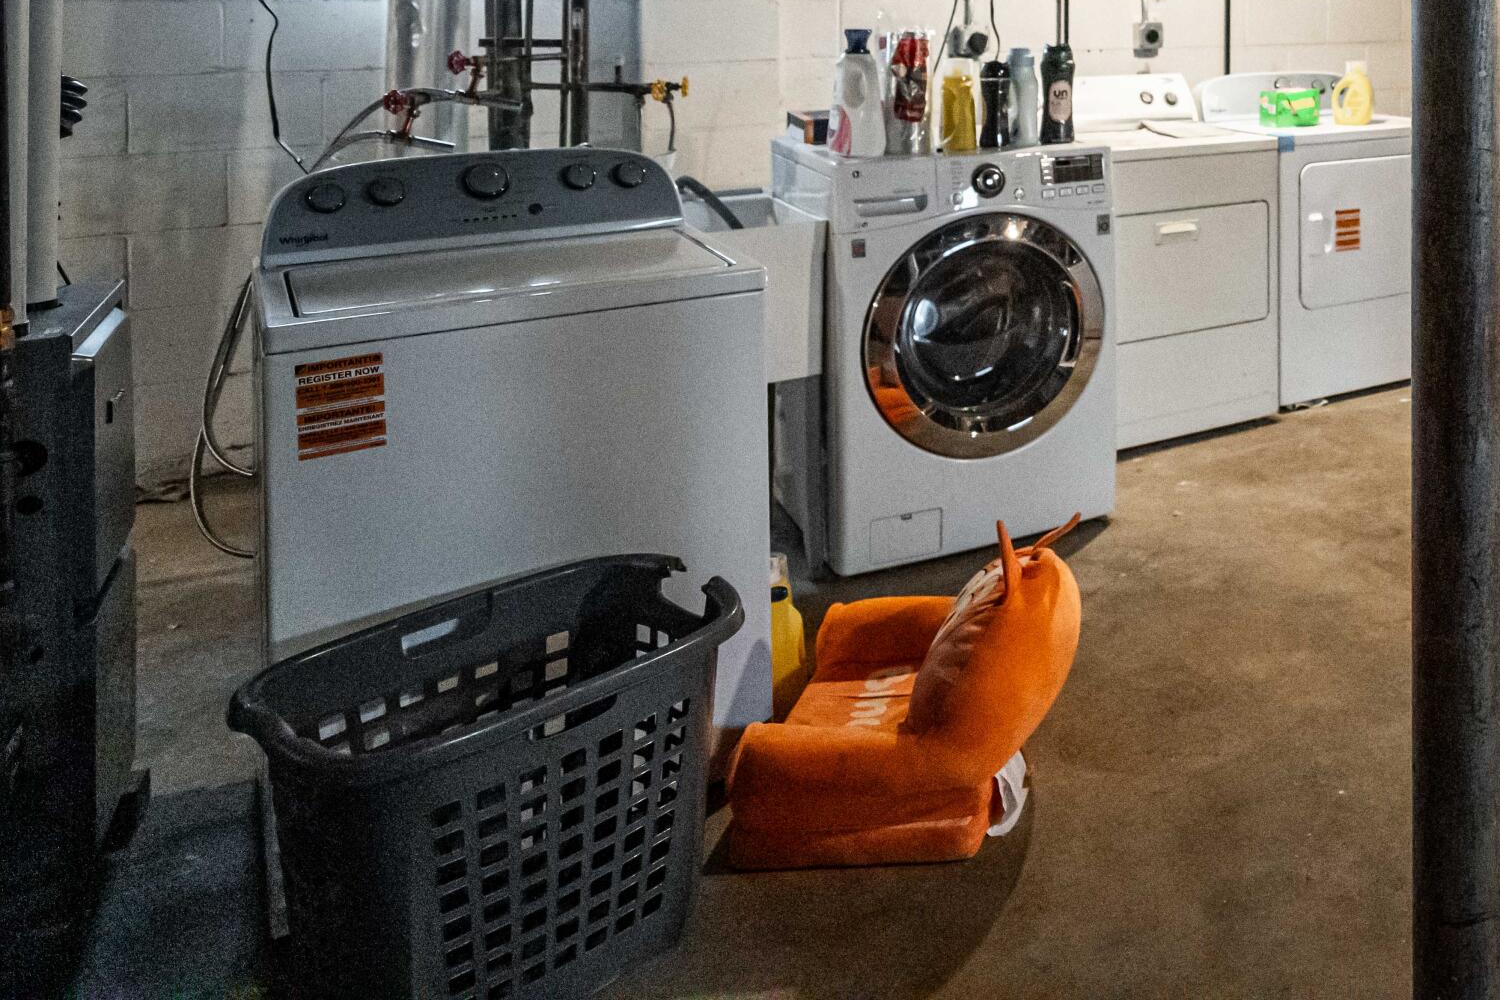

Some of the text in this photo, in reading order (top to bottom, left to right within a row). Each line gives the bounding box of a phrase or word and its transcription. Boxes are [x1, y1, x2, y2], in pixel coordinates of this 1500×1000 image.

[279, 233, 328, 246] Whirlpool
[298, 370, 352, 385] REGISTER
[355, 366, 380, 376] NOW
